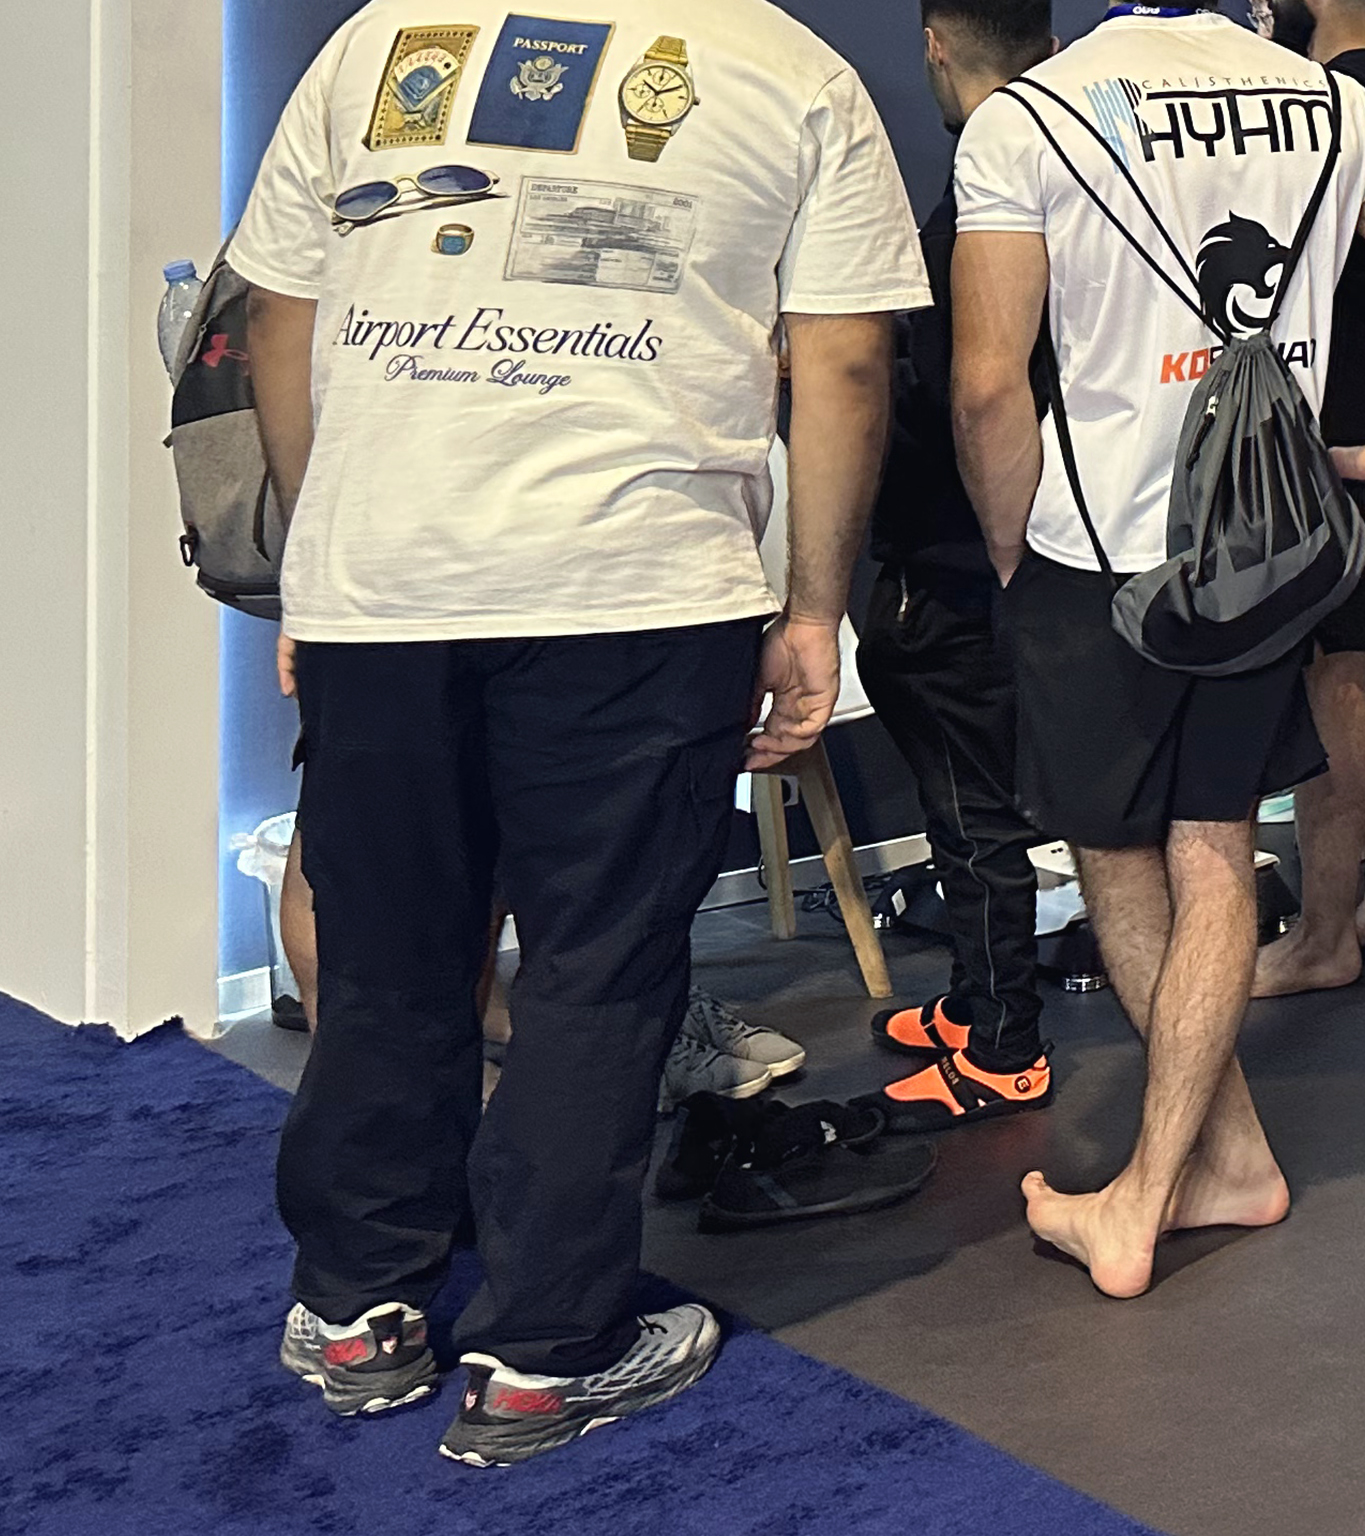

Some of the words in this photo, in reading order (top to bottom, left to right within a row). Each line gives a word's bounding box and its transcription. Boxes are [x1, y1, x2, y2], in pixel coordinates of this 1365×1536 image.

[512, 35, 588, 55] PASSPORT
[1141, 75, 1327, 90] CALISTHENICS
[333, 302, 456, 361] Airport
[454, 307, 663, 362] Essentials
[384, 353, 481, 383] Premium
[485, 358, 572, 395] Lounge
